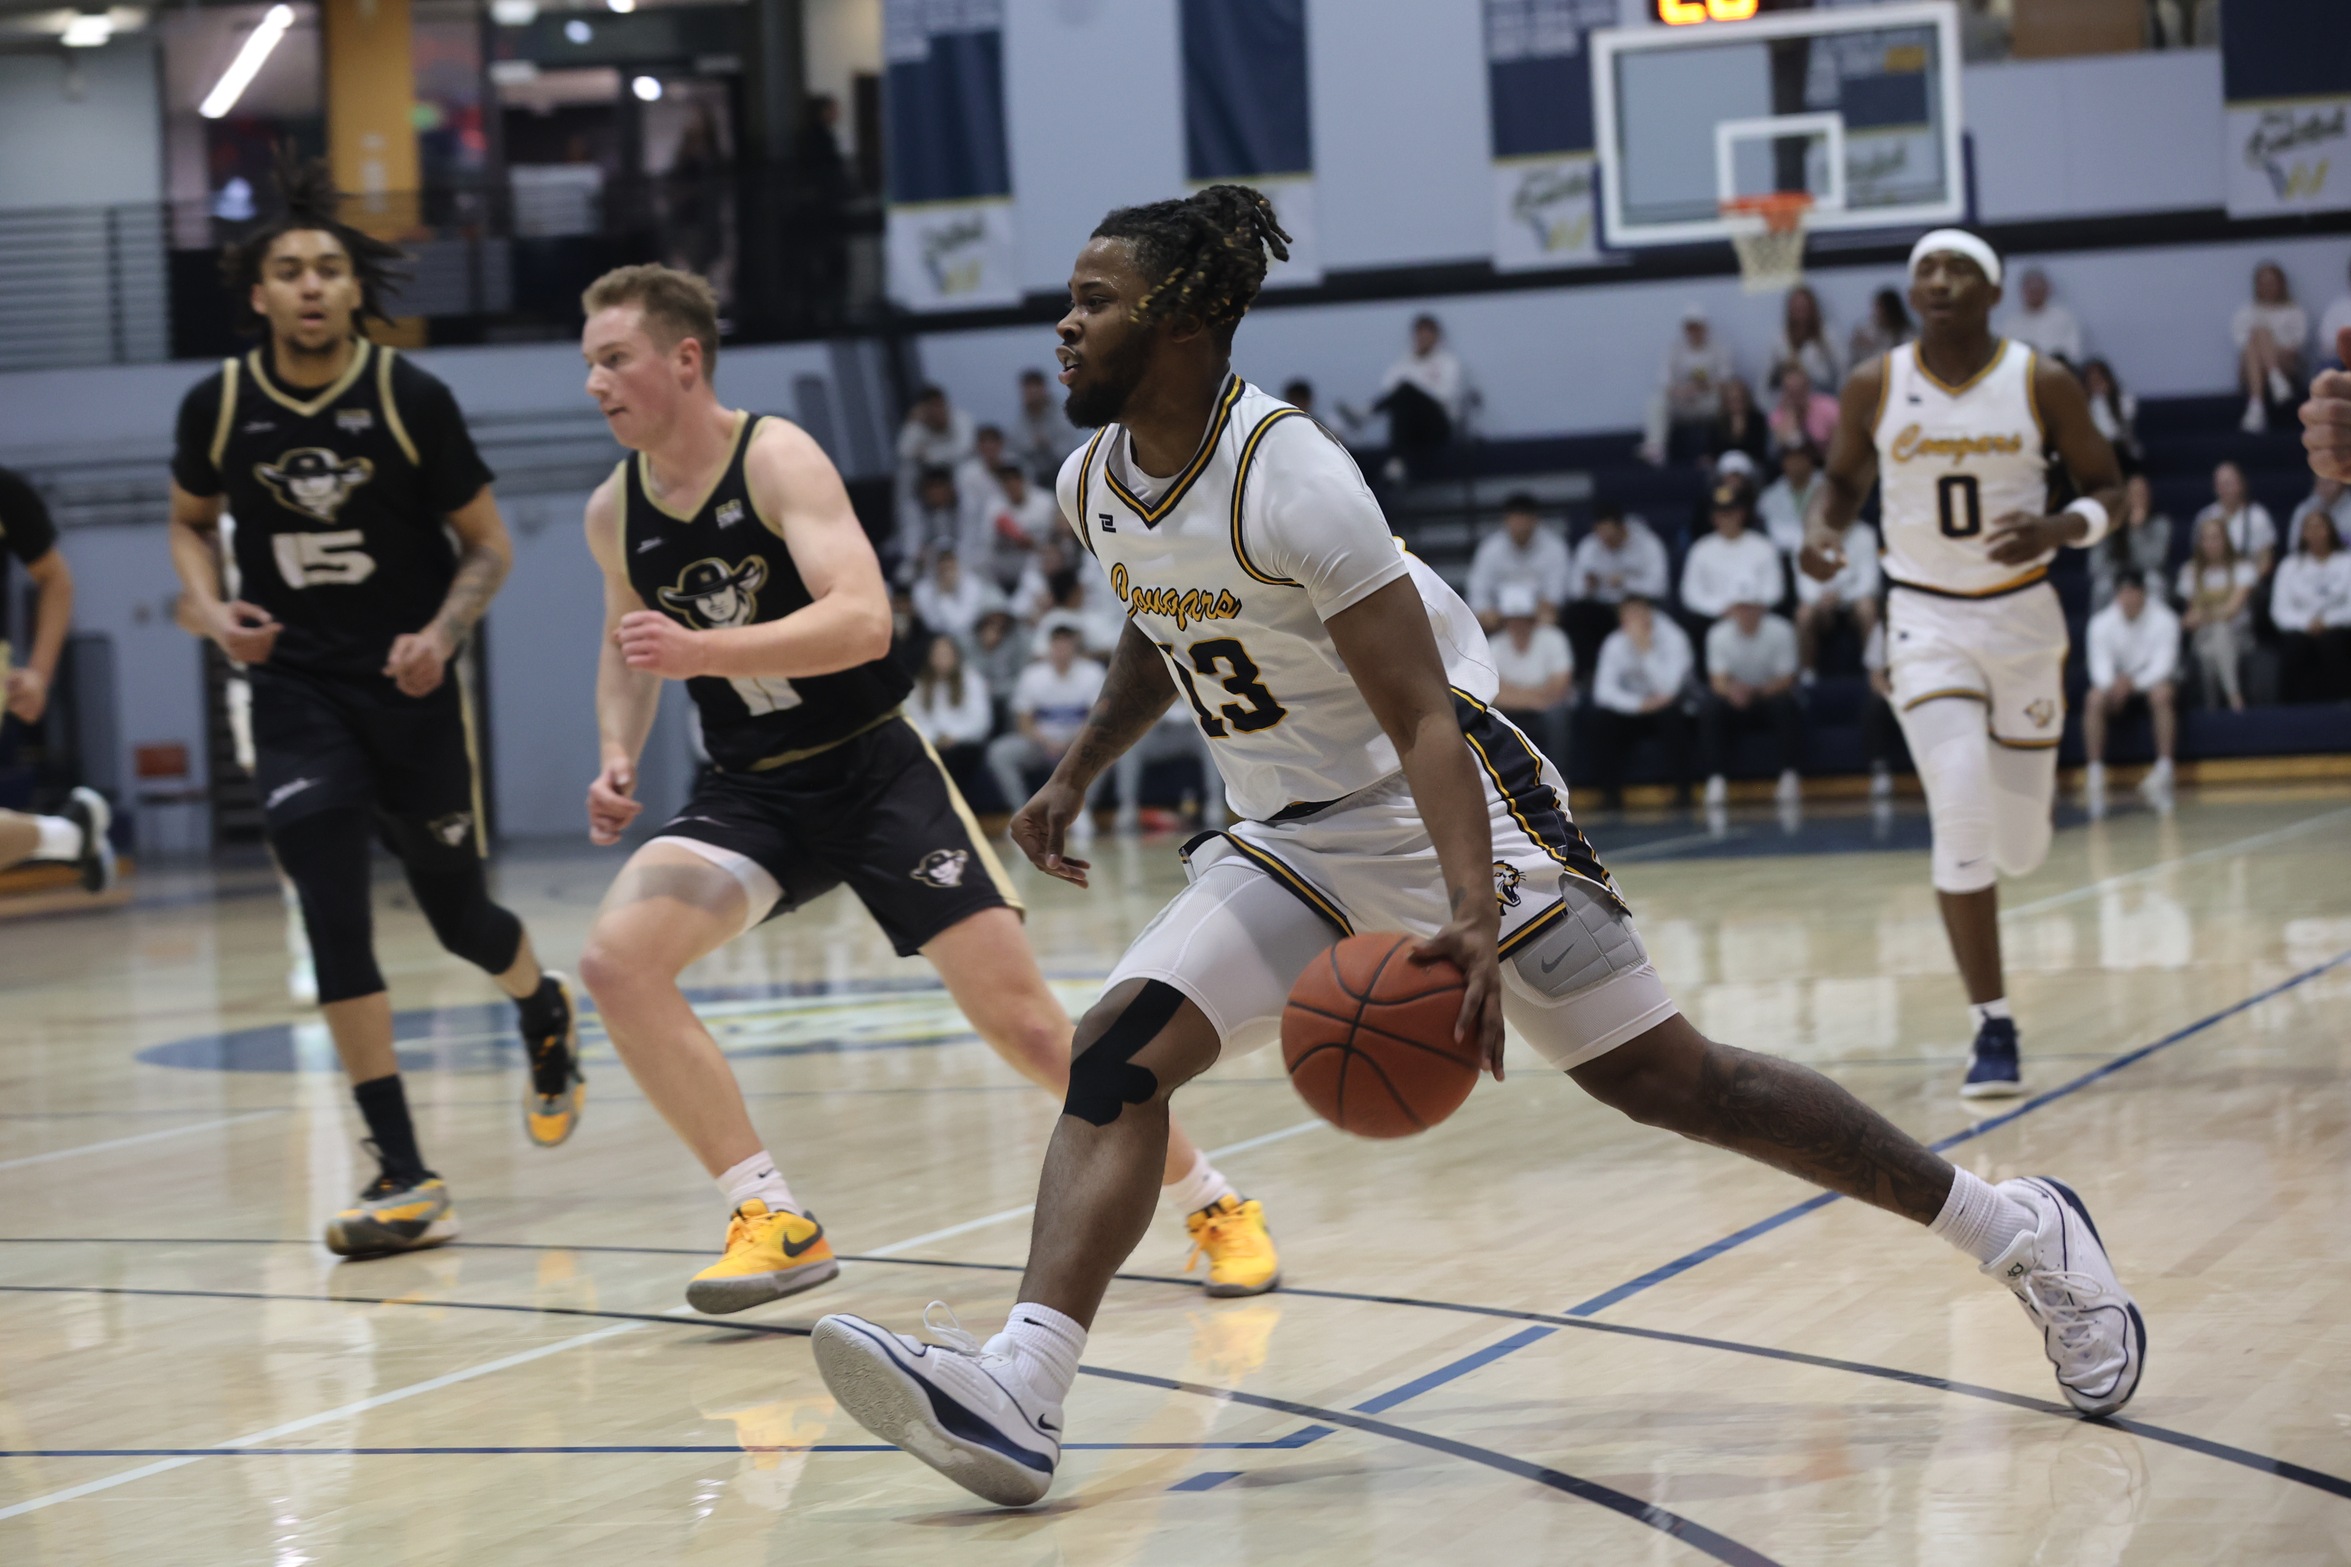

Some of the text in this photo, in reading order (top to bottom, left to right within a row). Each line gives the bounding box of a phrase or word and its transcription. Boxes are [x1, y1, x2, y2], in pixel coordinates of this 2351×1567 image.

[1892, 423, 2022, 466] Cougars
[1936, 472, 1982, 540] 0
[272, 528, 377, 590] 15
[1111, 562, 1243, 631] Cougars
[1155, 637, 1289, 740] 13
